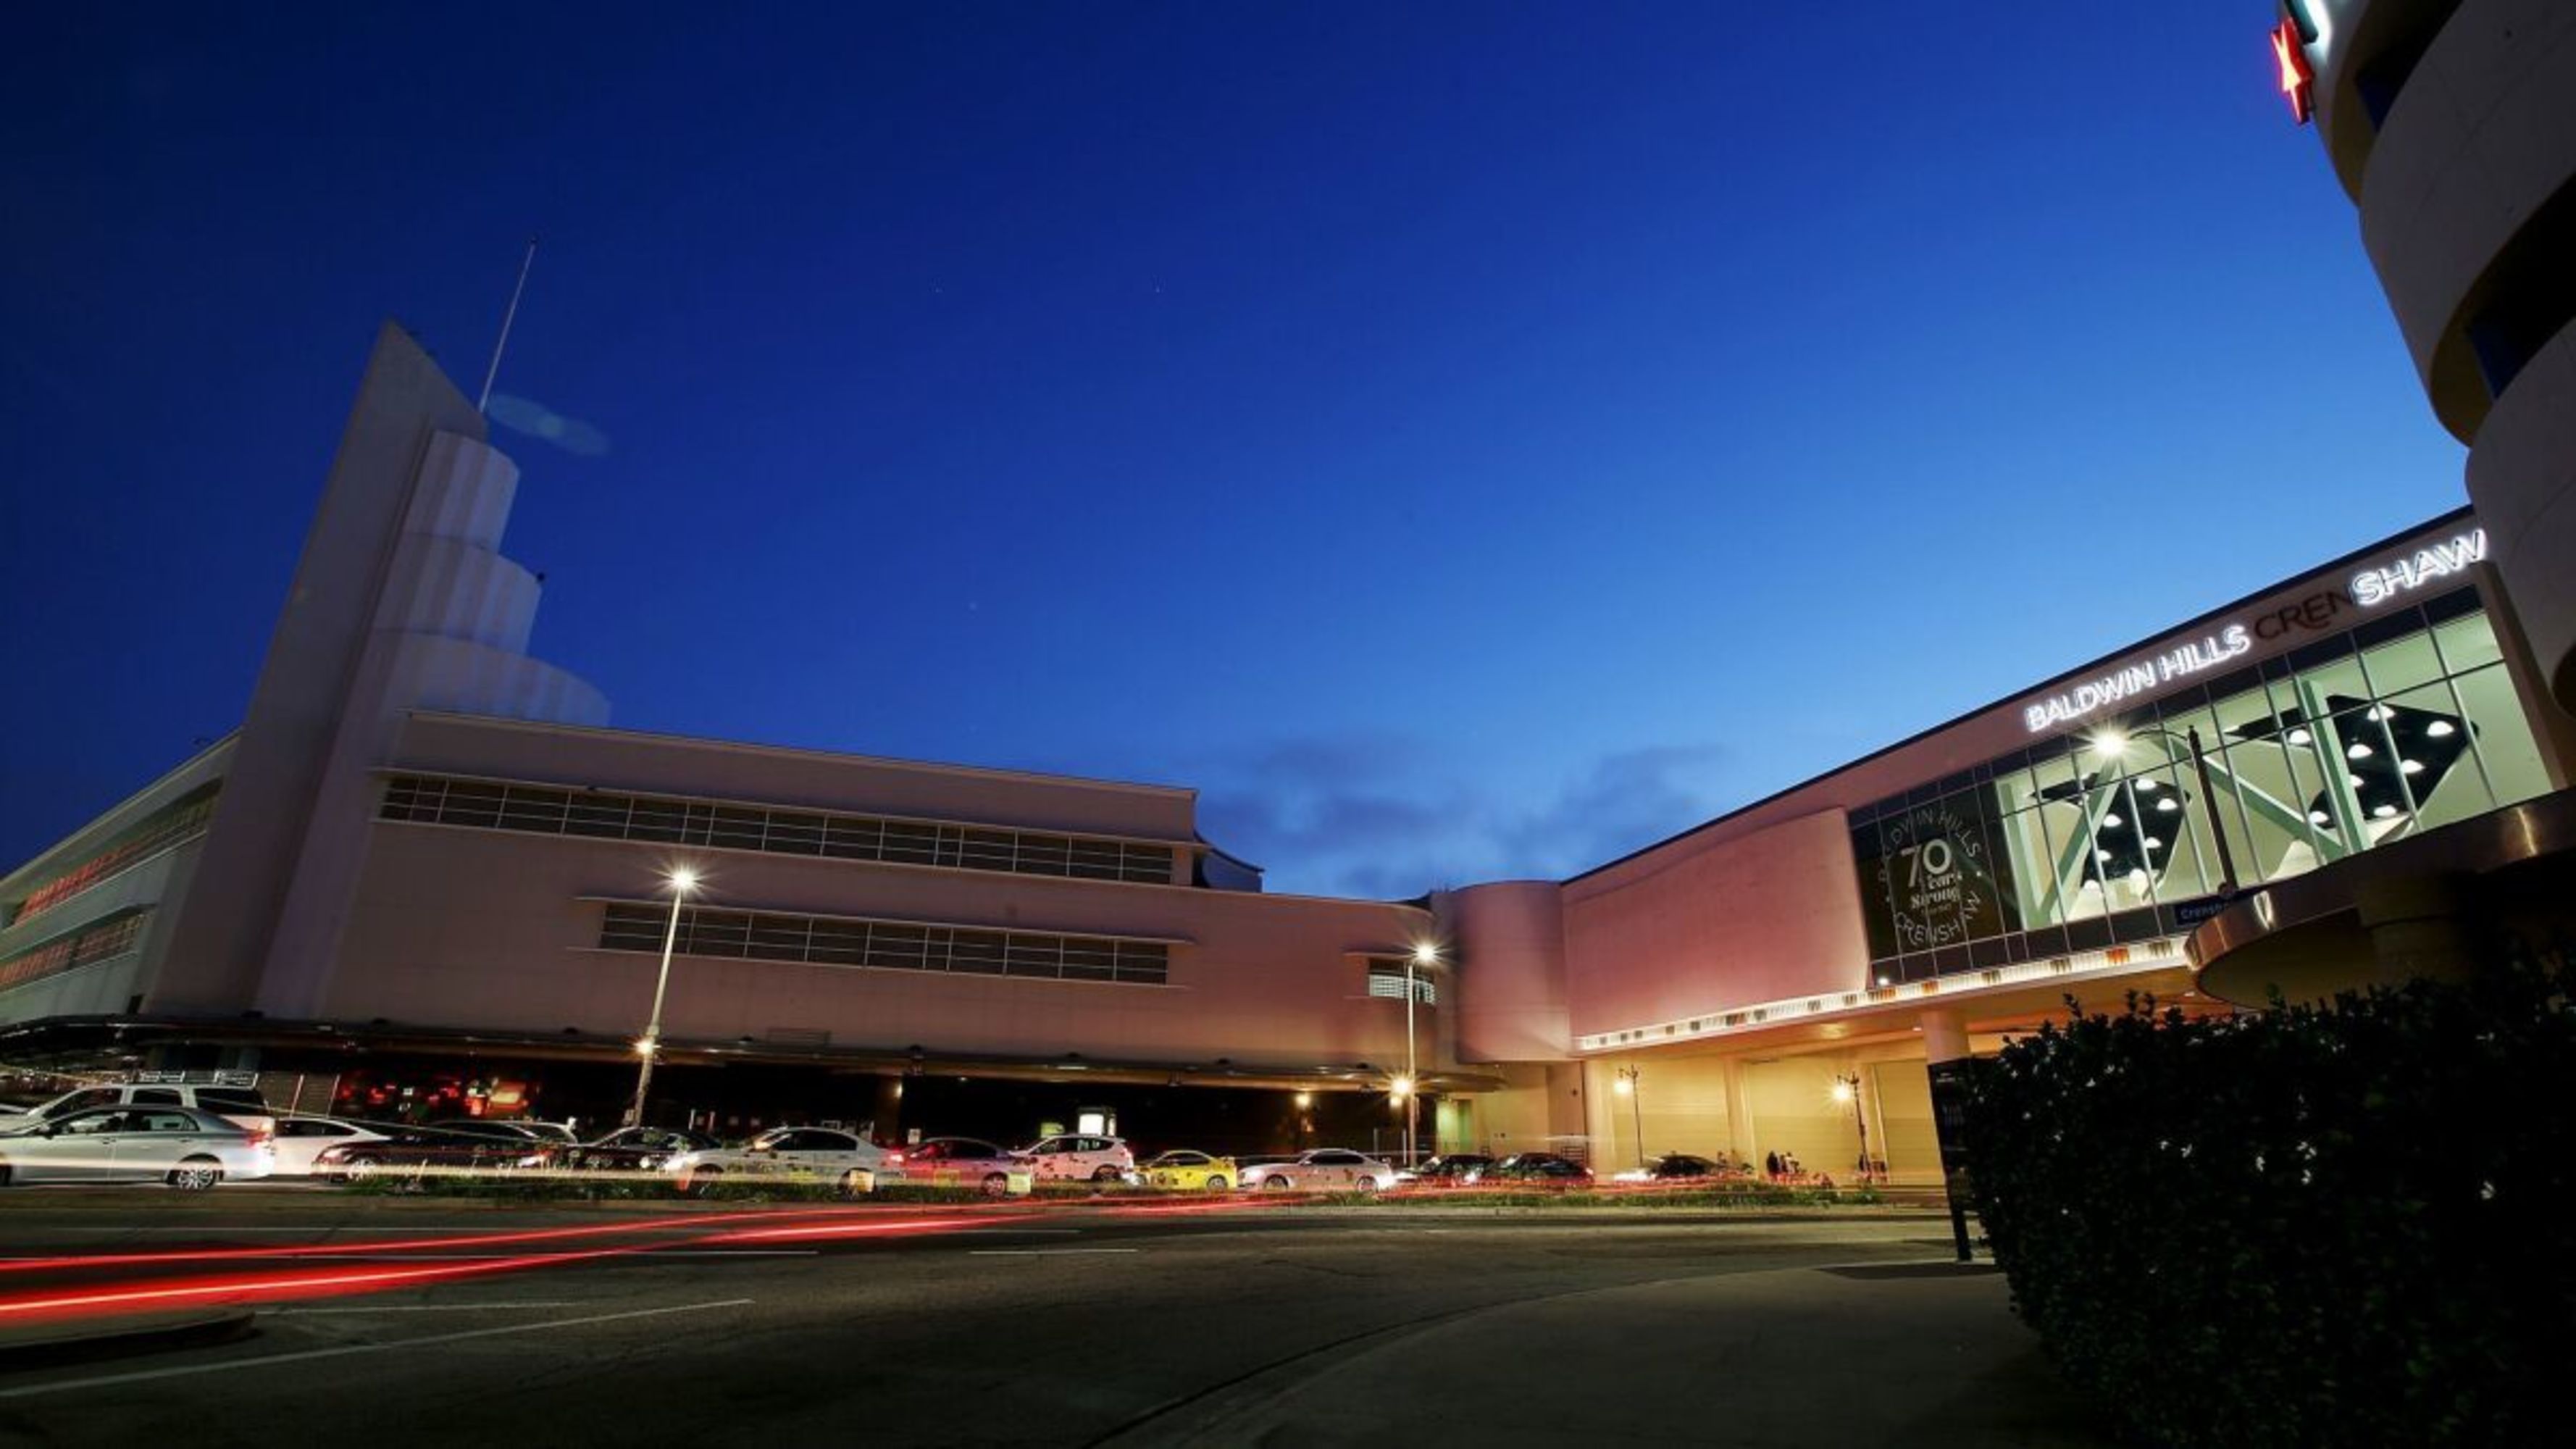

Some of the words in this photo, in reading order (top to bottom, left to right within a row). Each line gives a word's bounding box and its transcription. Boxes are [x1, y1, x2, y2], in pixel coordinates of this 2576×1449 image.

[2025, 662, 2156, 732] BALDWIN
[2158, 625, 2251, 680] HILLS
[2254, 529, 2485, 639] CRENSHAW
[1901, 838, 1952, 888] 70
[2180, 902, 2229, 919] Crensh
